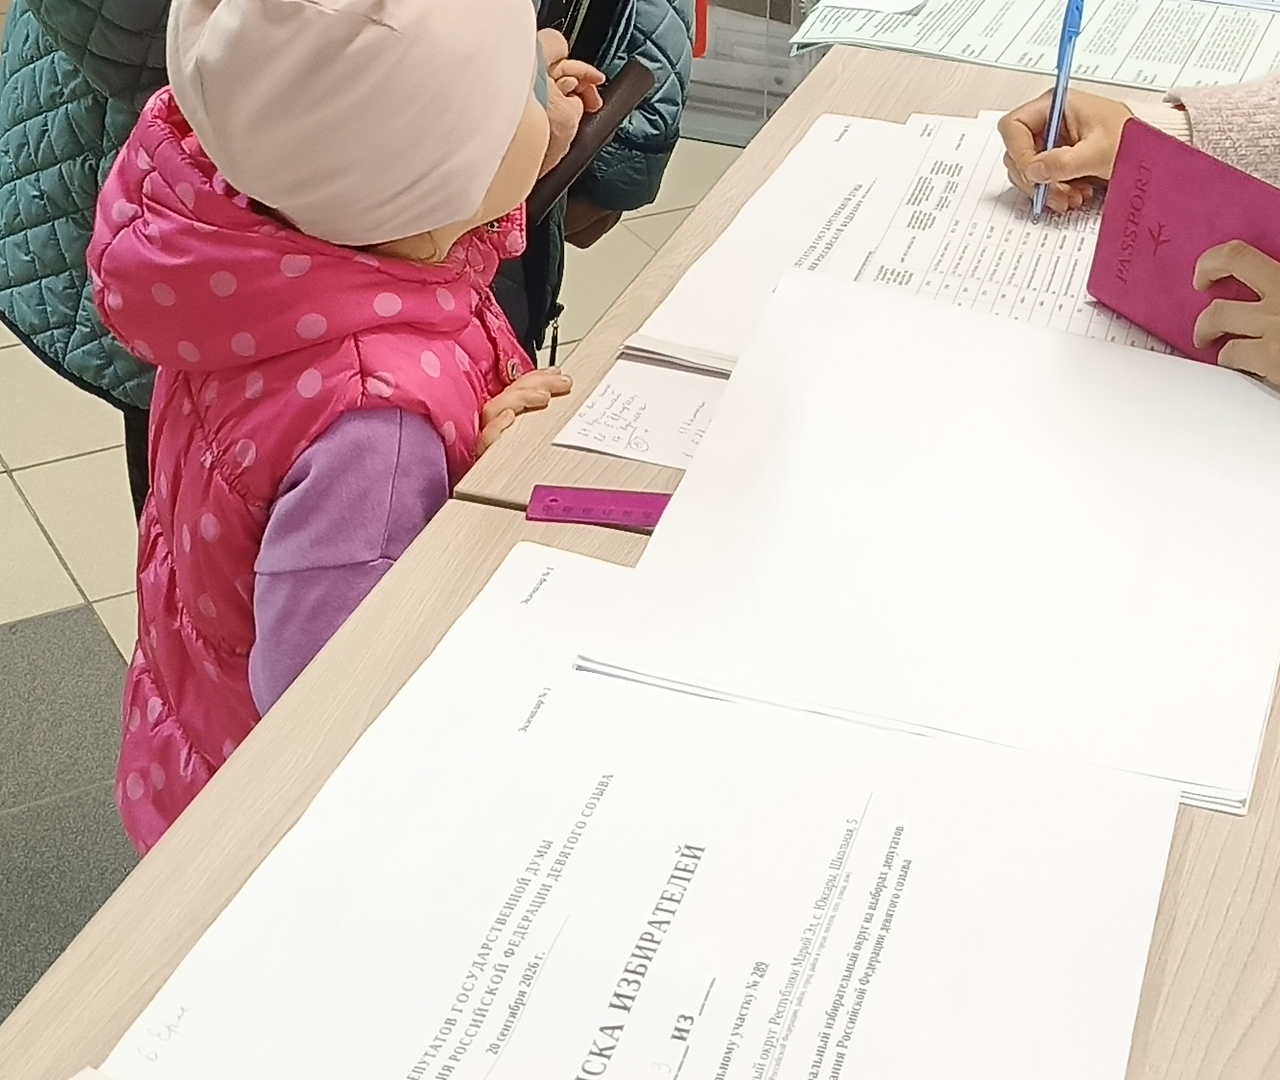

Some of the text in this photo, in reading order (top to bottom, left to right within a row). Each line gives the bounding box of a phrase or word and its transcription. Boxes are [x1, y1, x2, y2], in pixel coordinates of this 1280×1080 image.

[1116, 160, 1151, 285] PASSPORT
[828, 827, 859, 870] Школьная,
[882, 826, 904, 870] депутатов
[813, 873, 842, 911] Юксары,
[868, 871, 889, 911] выборах
[448, 963, 509, 1062] РОССИЙСКОЙ
[503, 883, 553, 958] ФЕДЕРАЦИИ
[546, 821, 587, 882] ДЕВЯТОГО
[581, 775, 613, 817] СОЗЫВА
[451, 878, 532, 1013] ГОСУДАРСТВЕННОЙ
[525, 840, 553, 876] ДУМЫ
[608, 844, 706, 1014] ИЗБИРАТЕЛЕЙ
[853, 924, 870, 951] округ
[863, 913, 874, 924] на
[750, 962, 769, 978] 289
[791, 937, 814, 968] Марий
[836, 987, 867, 1049] Российской
[858, 934, 886, 986] Федерации
[880, 893, 901, 933] девятого
[894, 859, 912, 891] созыва
[485, 951, 546, 1055] 20 сентября 2026 г.
[744, 979, 761, 992] №
[768, 969, 805, 1026] Республики
[824, 952, 859, 1029] избирательный
[670, 1014, 694, 1042] ИЗ
[731, 992, 757, 1039] участку
[760, 1028, 781, 1060] округ
